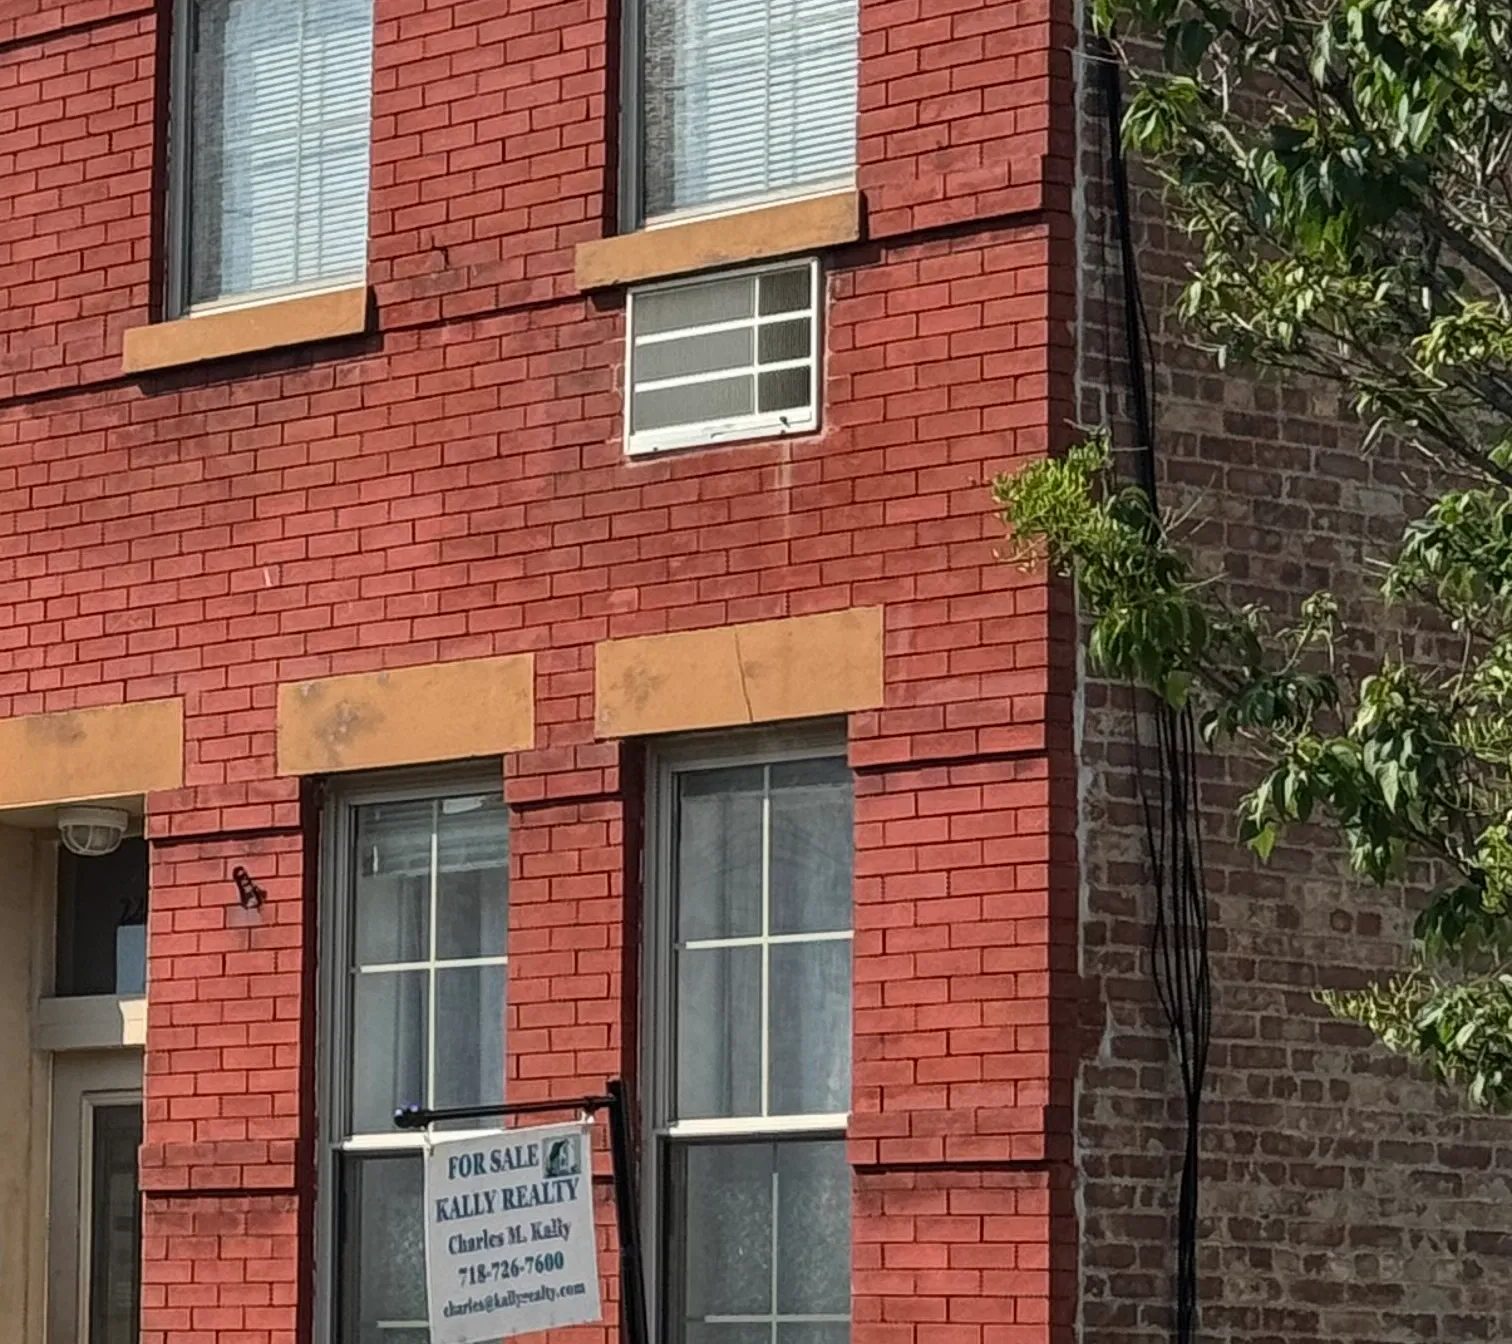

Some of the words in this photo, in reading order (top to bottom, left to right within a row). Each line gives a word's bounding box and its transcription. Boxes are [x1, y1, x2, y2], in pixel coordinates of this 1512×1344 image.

[448, 1152, 487, 1180] FOR
[490, 1143, 539, 1173] SALE
[436, 1188, 496, 1223] KALLY
[502, 1177, 579, 1211] REALTY
[448, 1228, 504, 1255] Charles
[507, 1224, 527, 1244] M.
[530, 1217, 571, 1242] Kally
[458, 1251, 565, 1287] 718-726-7600
[443, 1282, 586, 1318] charles@kallyrealty.com
